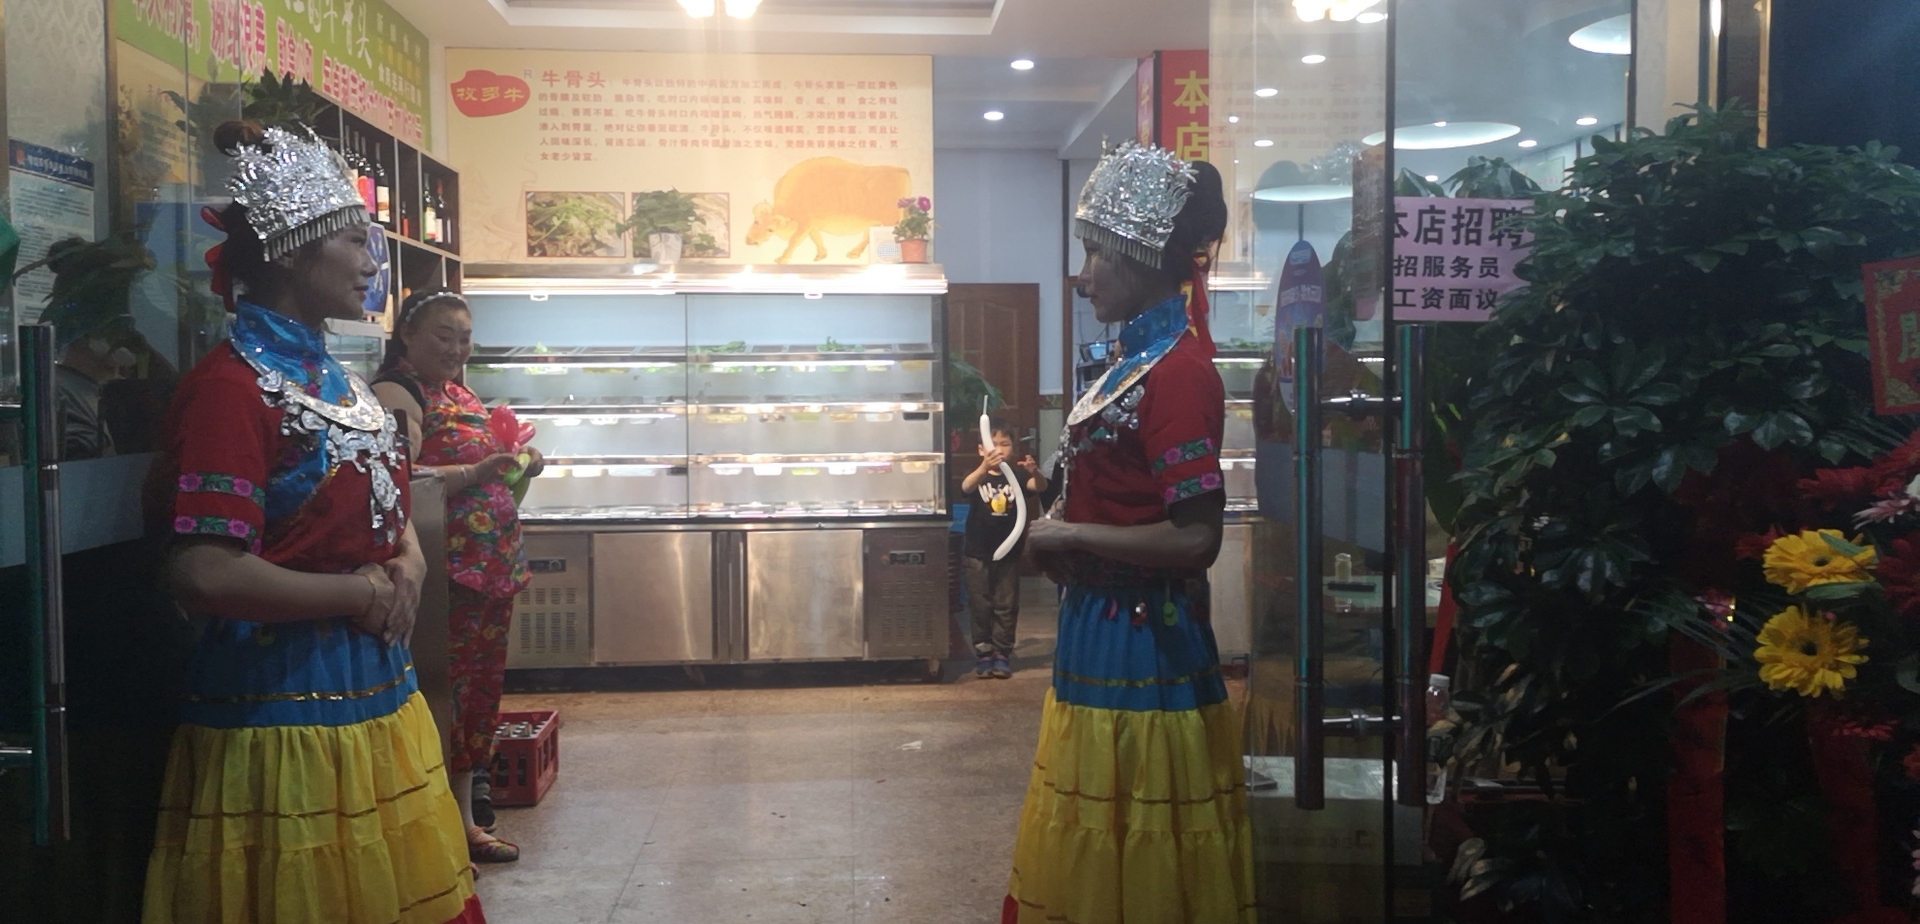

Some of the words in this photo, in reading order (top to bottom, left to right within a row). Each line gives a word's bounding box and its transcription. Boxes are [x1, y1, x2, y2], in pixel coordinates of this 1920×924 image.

[1172, 69, 1209, 161] 本店
[1393, 255, 1501, 279] 招服务员
[1393, 287, 1499, 311] 工资面议
